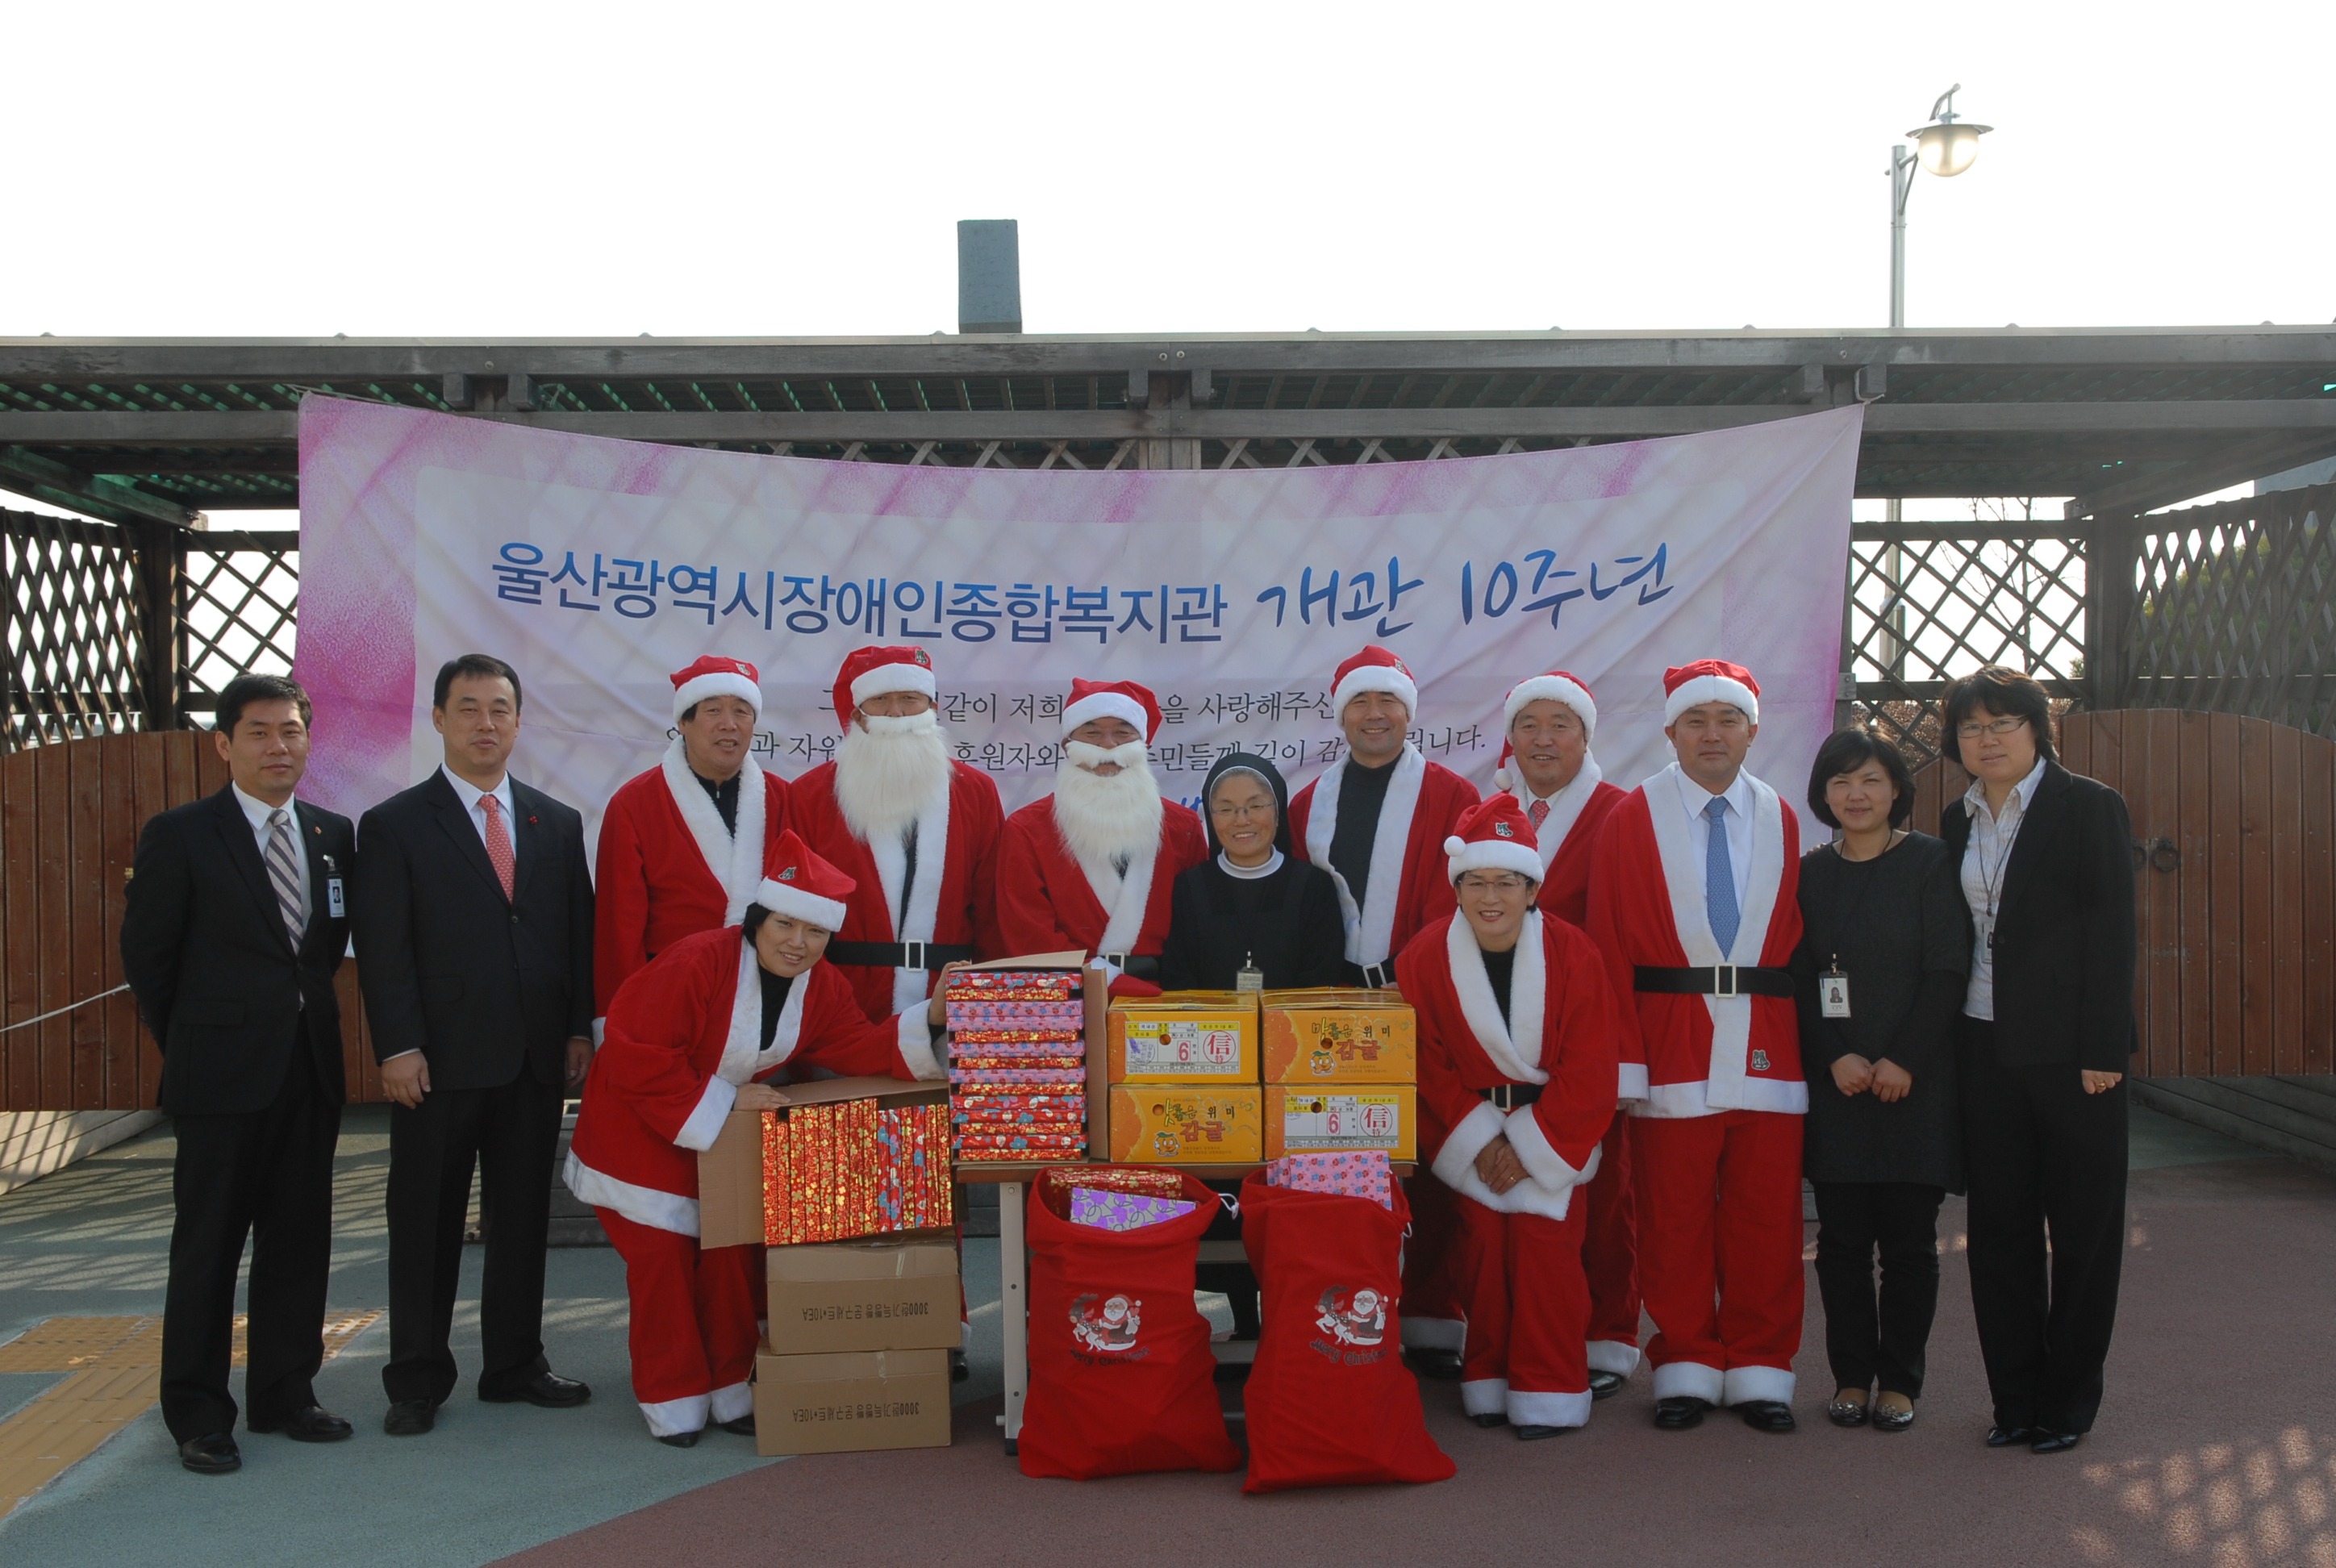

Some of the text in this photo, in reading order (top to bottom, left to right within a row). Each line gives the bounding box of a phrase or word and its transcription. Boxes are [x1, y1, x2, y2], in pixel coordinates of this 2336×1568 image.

[492, 541, 1675, 644] 울산광역시장애인종합복지관 개관 10주년
[1009, 694, 1065, 724] 저희
[1178, 1041, 1190, 1061] 6
[1207, 1033, 1233, 1055] 信
[1335, 1039, 1382, 1061] 감귤
[1328, 1113, 1339, 1134] 6
[1363, 1107, 1388, 1128] 信
[1179, 1120, 1226, 1142] 감귤
